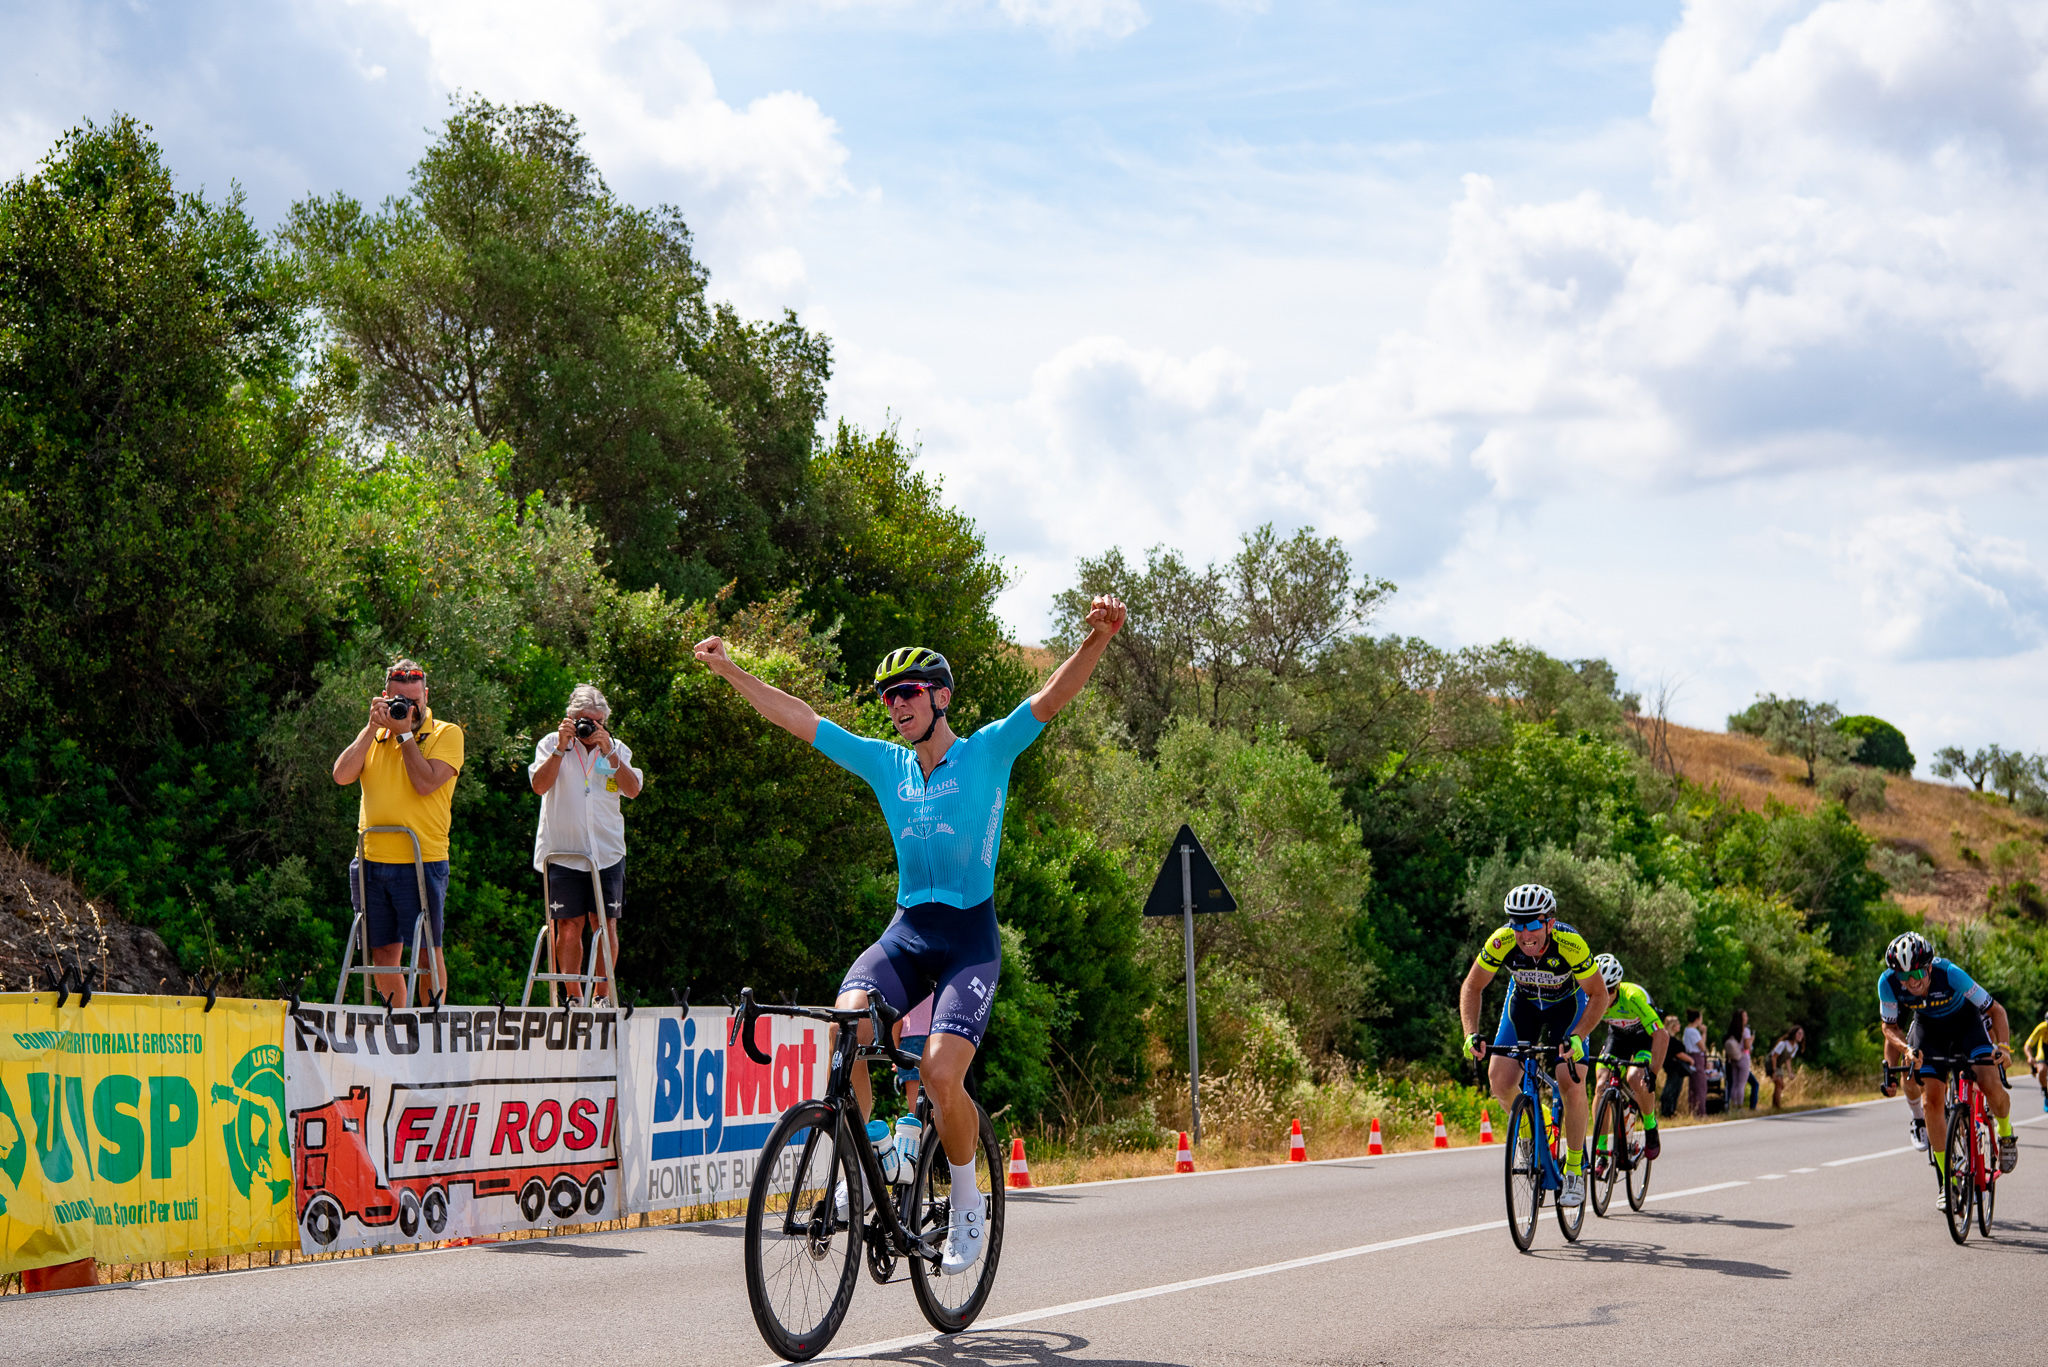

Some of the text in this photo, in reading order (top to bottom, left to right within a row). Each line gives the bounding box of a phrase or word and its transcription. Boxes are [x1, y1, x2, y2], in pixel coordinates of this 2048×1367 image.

[142, 1033, 203, 1055] GROSSETO
[252, 1049, 280, 1067] UISP
[652, 1017, 817, 1156] BigMat
[27, 1072, 199, 1184] UISP
[649, 1151, 814, 1201] HOME OF BUDER
[113, 1202, 147, 1228] Sport
[149, 1200, 170, 1223] Per
[173, 1197, 198, 1221] tutti
[828, 1153, 862, 1331] BONTRAGER
